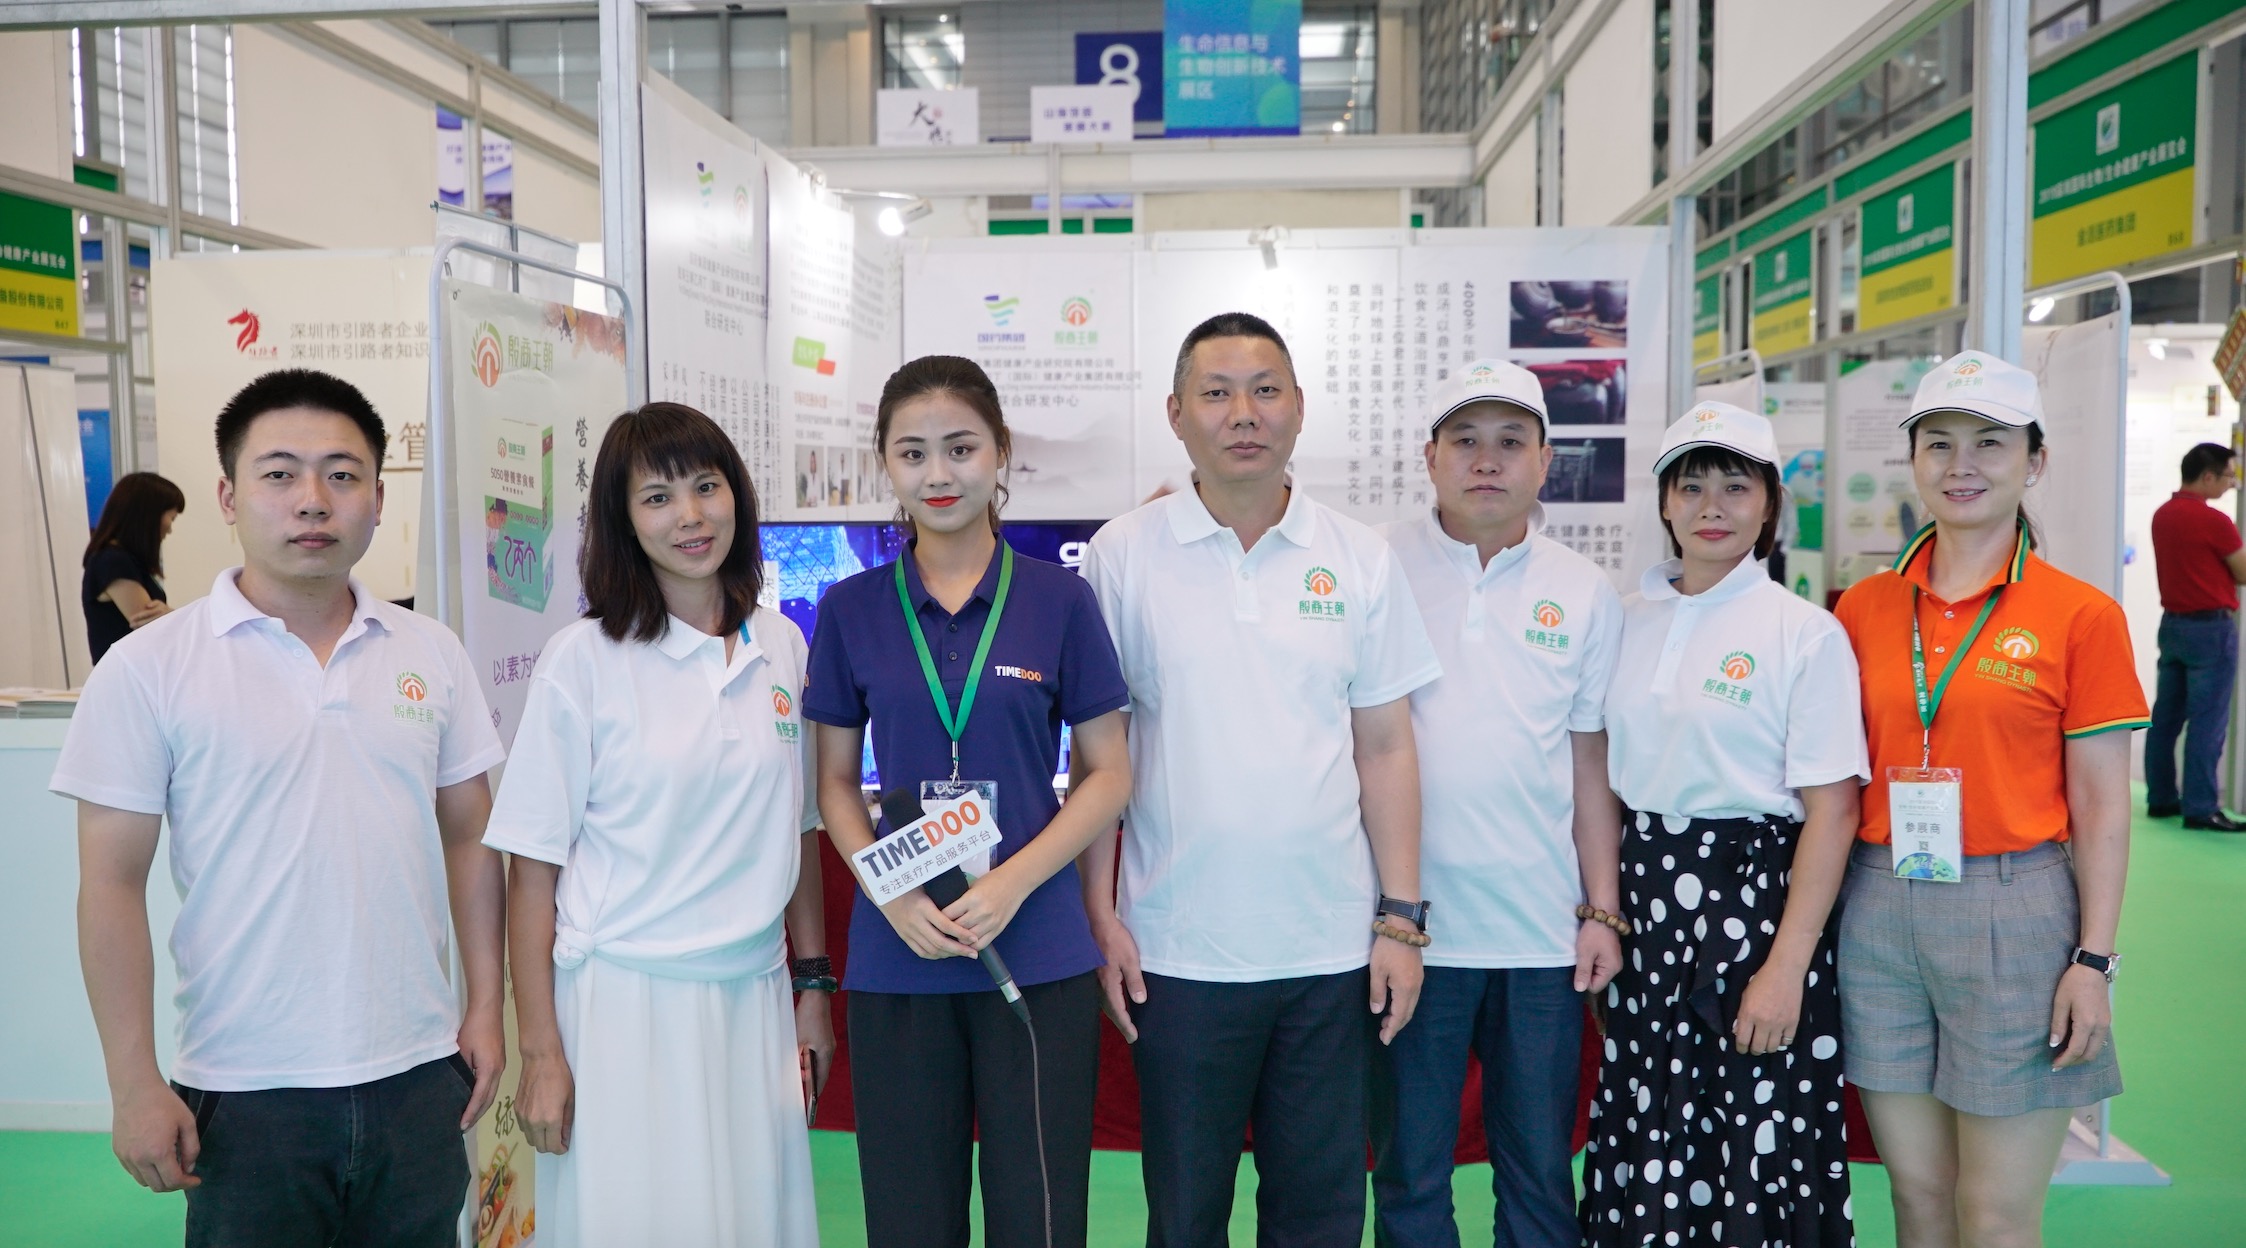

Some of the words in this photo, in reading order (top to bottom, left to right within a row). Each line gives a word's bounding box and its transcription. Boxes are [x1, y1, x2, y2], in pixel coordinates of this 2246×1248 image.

[1099, 44, 1141, 104] 8
[1179, 80, 1214, 100] 展区
[290, 322, 428, 339] 深圳市引路者企业
[508, 335, 553, 372] 殷商王朝
[1299, 600, 1345, 617] 殷商王朝
[1525, 629, 1569, 650] 殷商王朝
[995, 665, 1042, 683] TIMEDOO
[1976, 657, 2037, 687] 殷商王朝
[1702, 678, 1753, 706] 殷商王朝
[393, 704, 434, 724] 殷商王朝
[1905, 821, 1941, 835] 参展商
[860, 800, 981, 878] TIMEDOO
[879, 829, 992, 896] 专注医疗产品服务平台
